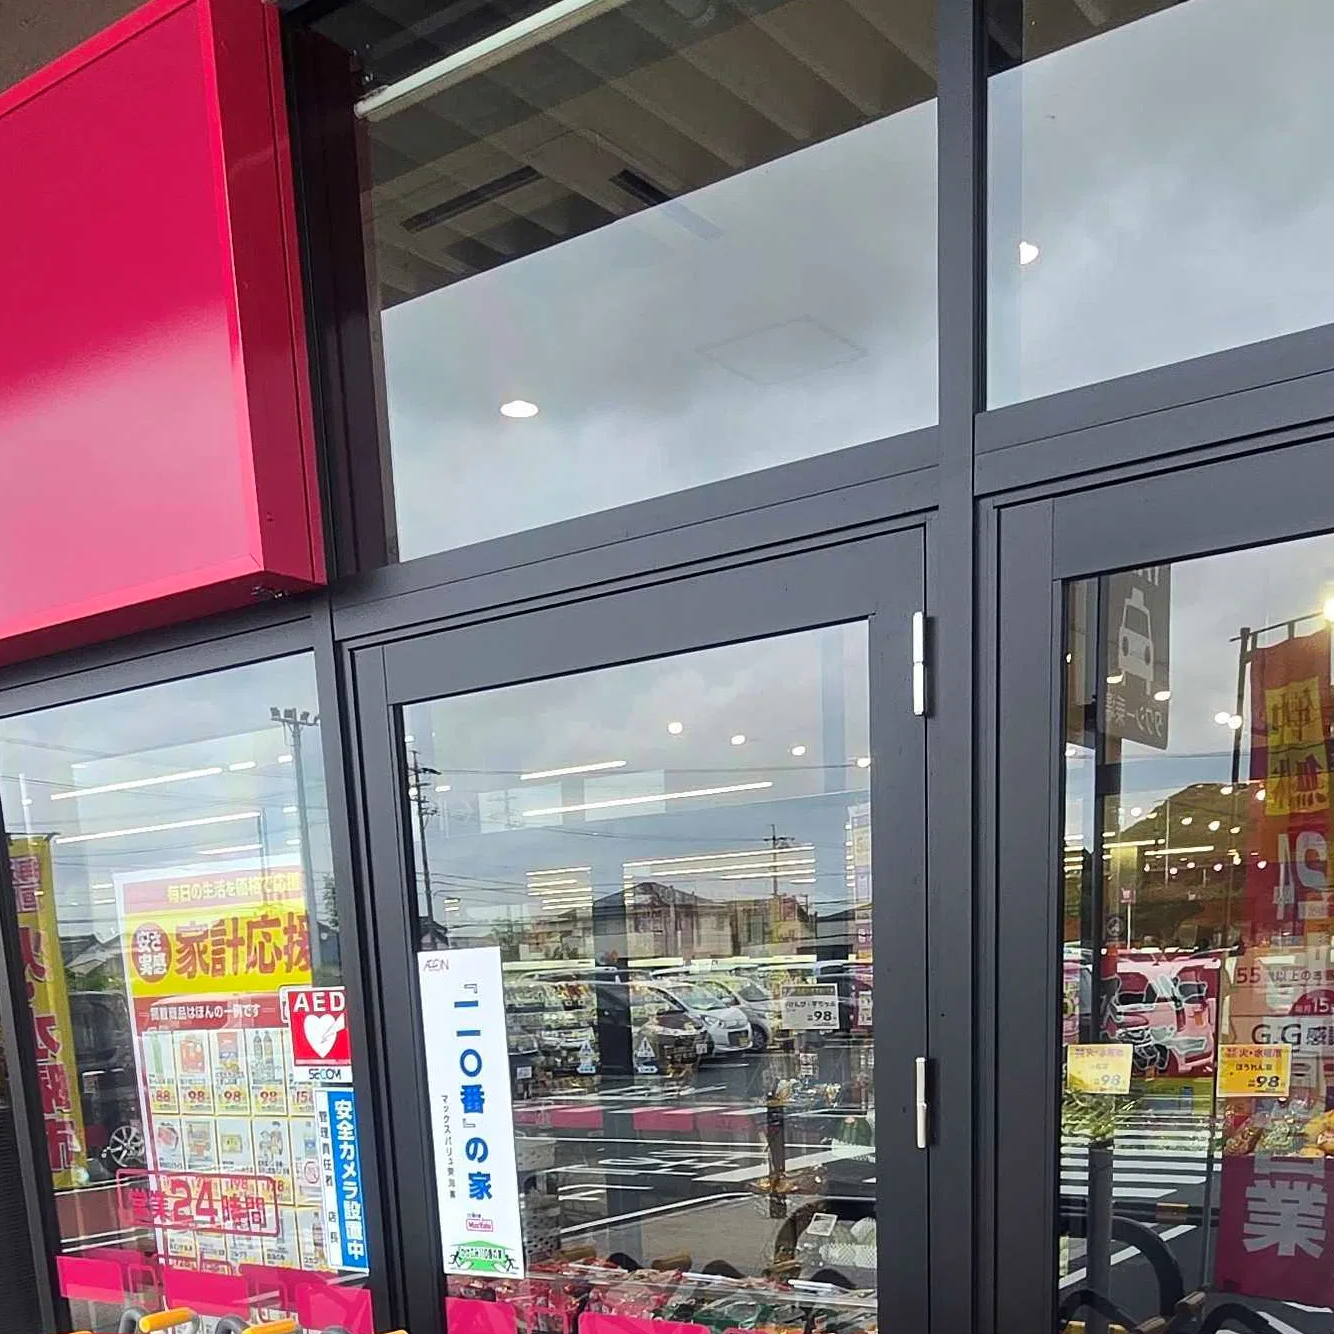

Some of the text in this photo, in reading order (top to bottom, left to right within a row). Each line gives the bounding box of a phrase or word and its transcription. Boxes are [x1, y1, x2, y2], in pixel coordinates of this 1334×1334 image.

[294, 992, 345, 1013] AED
[813, 1010, 833, 1022] 98
[308, 1069, 342, 1081] SECOM
[1256, 1075, 1281, 1088] 98
